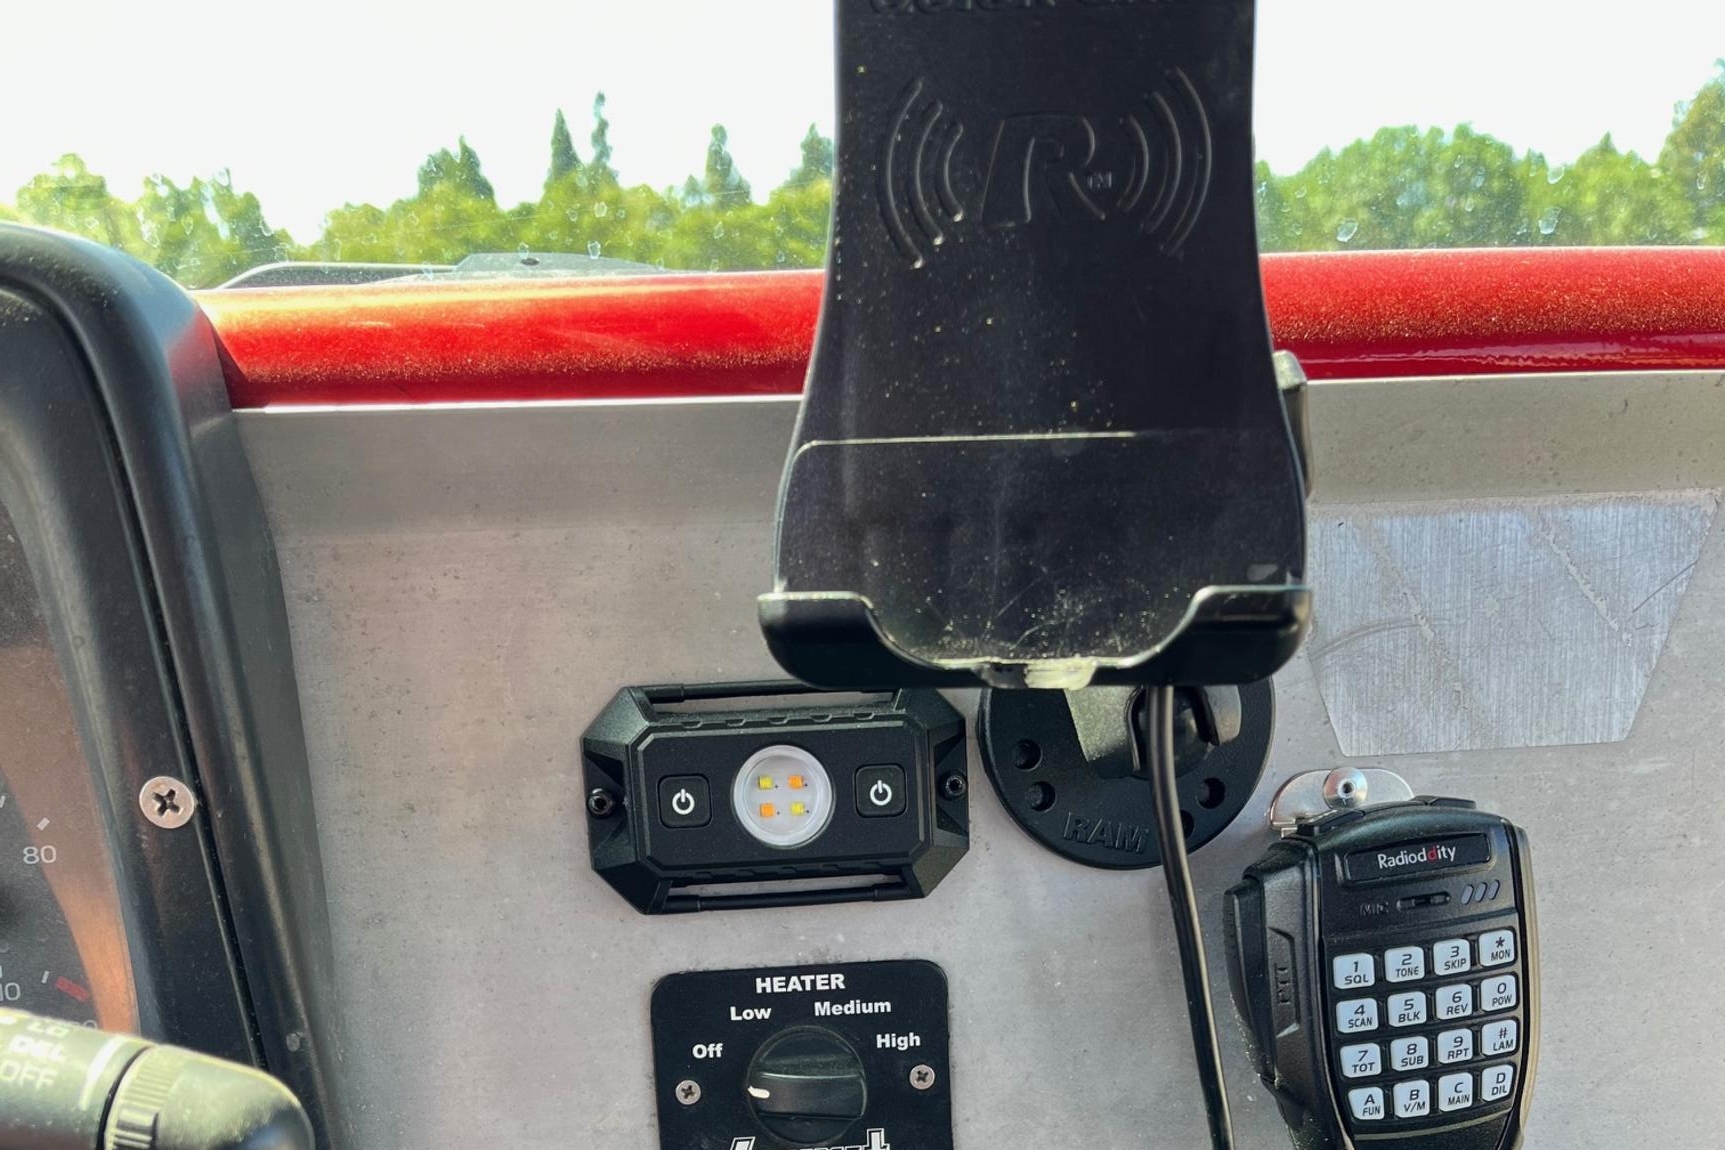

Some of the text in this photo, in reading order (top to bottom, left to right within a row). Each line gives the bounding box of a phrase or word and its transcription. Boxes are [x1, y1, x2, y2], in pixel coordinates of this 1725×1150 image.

[1063, 811, 1145, 855] RAM
[23, 845, 57, 865] 80
[1377, 844, 1457, 869] Radioddity
[1450, 945, 1460, 958] 3
[1490, 949, 1511, 961] MON
[1401, 954, 1413, 966] 2
[1444, 958, 1467, 970] SKIP
[1353, 960, 1359, 973] 1
[1396, 966, 1419, 978] TONE
[755, 973, 846, 994] HEATER
[1344, 975, 1369, 985] SQL
[1452, 991, 1462, 1003] 6
[1492, 995, 1512, 1007] POW
[814, 1000, 892, 1017] Medium
[1353, 1004, 1366, 1016] 4
[1403, 998, 1415, 1011] 5
[1446, 1004, 1469, 1016] REV
[729, 1006, 772, 1021] Low
[1398, 1011, 1421, 1023] BLK
[1348, 1017, 1373, 1029] SCAN
[876, 1032, 921, 1051] High
[1453, 1036, 1463, 1048] 9
[692, 1043, 724, 1059] Off
[1406, 1043, 1417, 1055] 8
[1447, 1048, 1470, 1060] RPT
[1358, 1050, 1369, 1062] 7
[1401, 1055, 1424, 1067] SUB
[1352, 1062, 1375, 1073] TOT
[1496, 1072, 1506, 1084] D
[1454, 1082, 1464, 1094] C
[1364, 1094, 1376, 1106] A
[1409, 1089, 1420, 1101] B
[1447, 1094, 1470, 1106] MAIN
[1362, 1106, 1381, 1117] FUN
[1404, 1101, 1425, 1112] V/M
